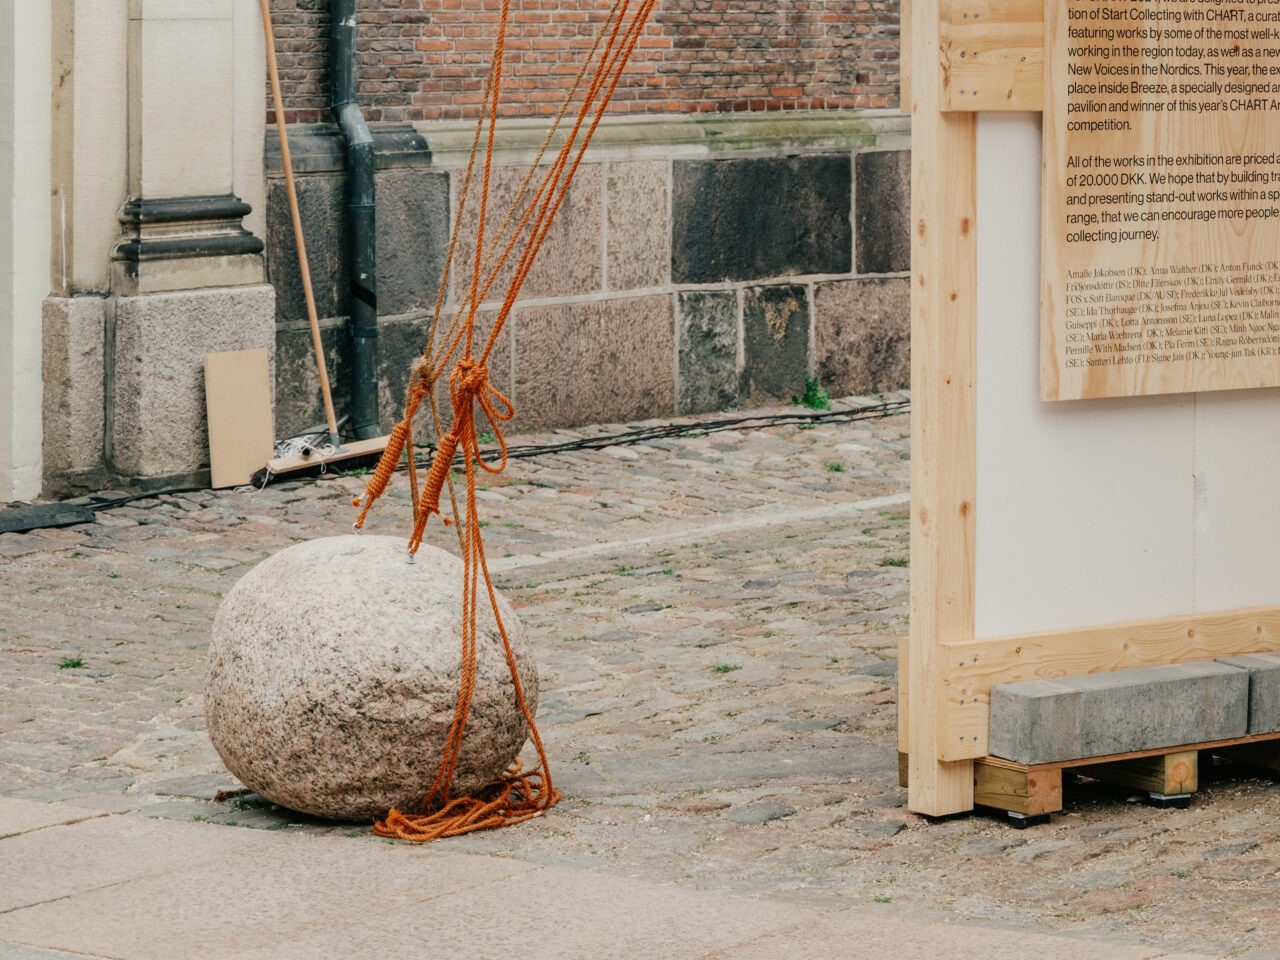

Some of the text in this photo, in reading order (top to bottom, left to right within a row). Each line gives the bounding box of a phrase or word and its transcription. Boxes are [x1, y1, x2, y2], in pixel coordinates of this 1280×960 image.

[1068, 6, 1087, 20] tion
[1089, 6, 1099, 20] of
[1102, 7, 1127, 20] Start
[1129, 7, 1181, 24] Collecting
[1183, 7, 1204, 21] with
[1206, 8, 1246, 23] CHART,
[1247, 11, 1253, 21] a
[1068, 25, 1114, 41] featuring
[1116, 25, 1147, 38] works
[1149, 25, 1162, 42] by
[1164, 28, 1192, 39] some
[1194, 26, 1203, 39] of
[1206, 26, 1222, 39] the
[1223, 26, 1248, 39] most
[1067, 62, 1091, 75] New
[1094, 62, 1128, 75] Voices
[1130, 62, 1139, 75] in
[1141, 62, 1158, 75] the
[1159, 62, 1201, 75] Nordics.
[1204, 62, 1225, 75] This
[1226, 65, 1250, 78] year,
[1252, 62, 1267, 75] the
[1067, 80, 1096, 97] place
[1098, 80, 1128, 93] inside
[1130, 80, 1169, 95] Breeze,
[1170, 83, 1177, 93] a
[1179, 80, 1222, 96] specially
[1224, 80, 1270, 96] designed
[1067, 98, 1106, 115] pavilion
[1108, 98, 1128, 112] and
[1130, 98, 1163, 111] winner
[1166, 98, 1176, 111] of
[1179, 98, 1196, 111] this
[1229, 98, 1267, 111] CHART
[1067, 117, 1130, 134] competition.
[1067, 154, 1079, 167] All
[1081, 154, 1091, 167] of
[1094, 153, 1111, 167] the
[1113, 153, 1144, 166] works
[1146, 153, 1155, 166] in
[1157, 152, 1173, 166] the
[1175, 152, 1223, 165] exhibition
[1225, 154, 1241, 164] are
[1243, 151, 1274, 167] priced
[1066, 172, 1076, 186] of
[1079, 172, 1118, 185] 20.000
[1120, 171, 1146, 185] DKK.
[1149, 171, 1165, 184] We
[1167, 170, 1193, 187] hope
[1195, 170, 1214, 183] that
[1216, 169, 1229, 186] by
[1230, 169, 1268, 185] building
[1066, 191, 1086, 204] and
[1088, 189, 1144, 207] presenting
[1146, 188, 1194, 202] stand-out
[1197, 187, 1227, 201] works
[1229, 187, 1258, 200] within
[1259, 189, 1265, 199] a
[1066, 212, 1099, 226] range,
[1101, 208, 1120, 222] that
[1123, 211, 1138, 221] we
[1140, 210, 1159, 221] can
[1161, 209, 1216, 223] encourage
[1217, 208, 1243, 218] more
[1245, 204, 1279, 221] people
[1066, 225, 1158, 244] collecting journey.
